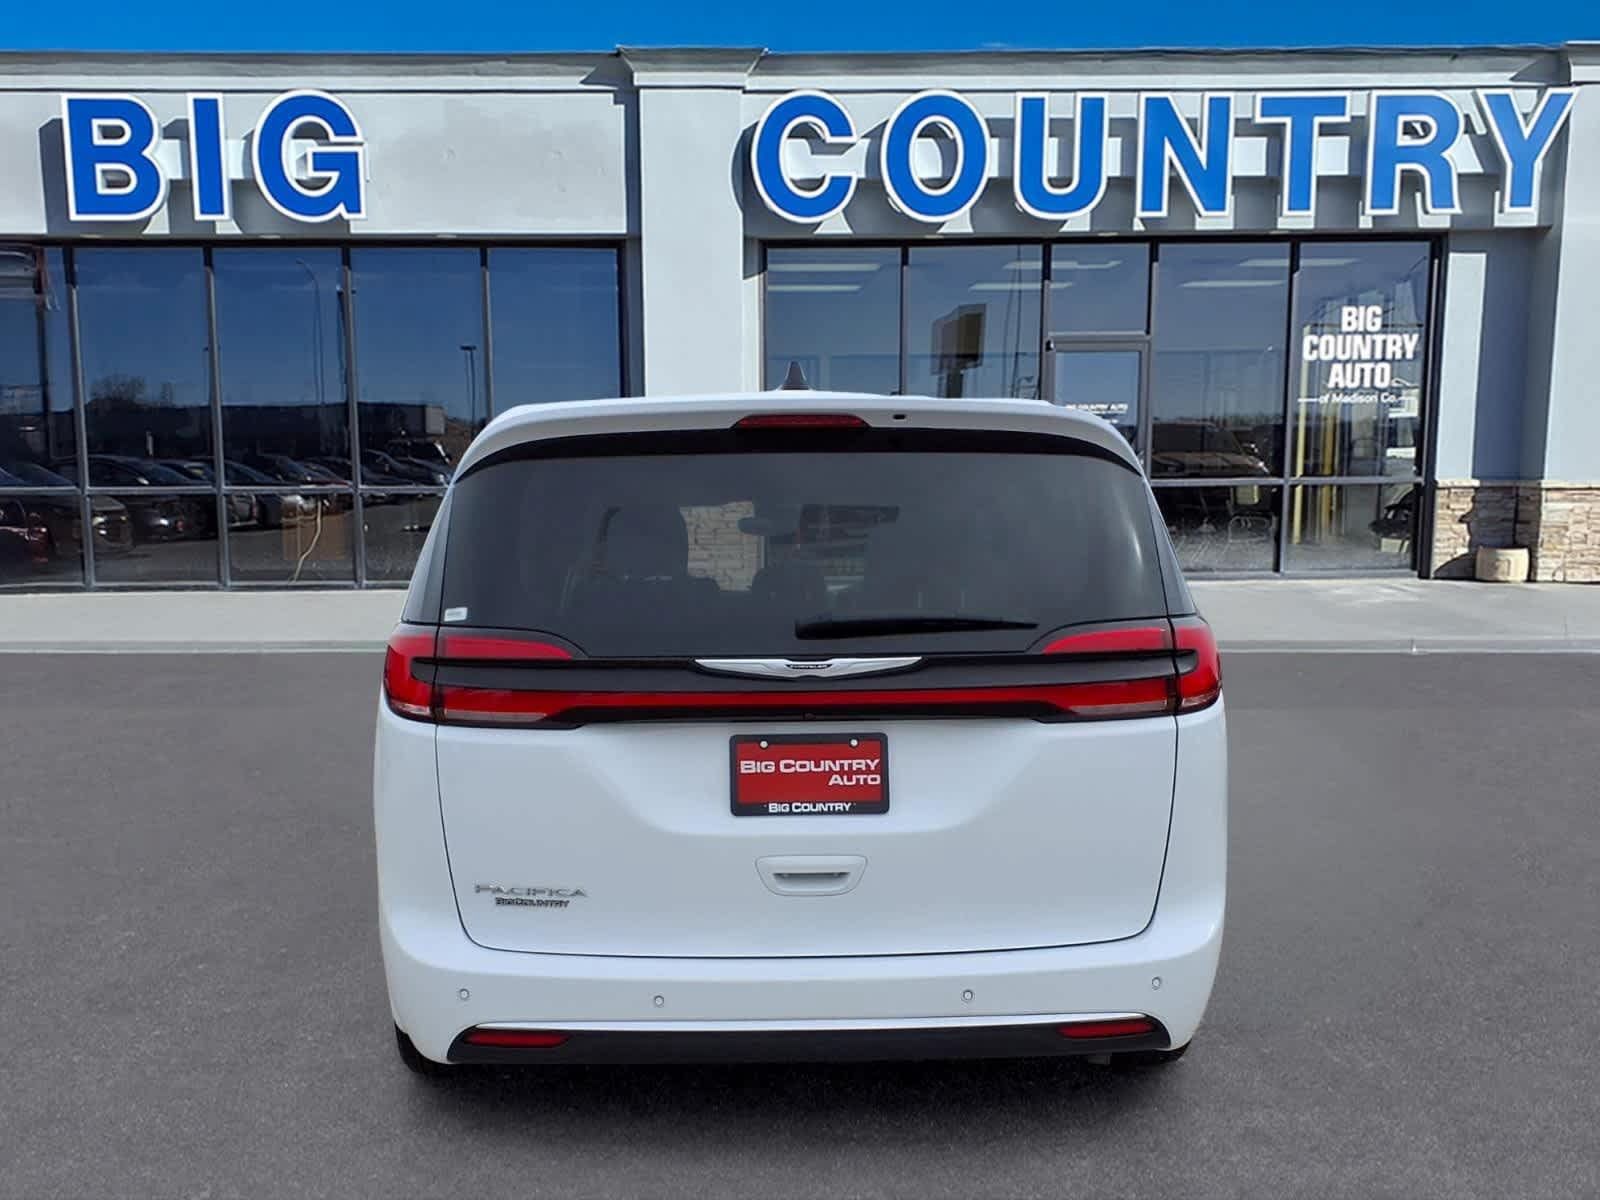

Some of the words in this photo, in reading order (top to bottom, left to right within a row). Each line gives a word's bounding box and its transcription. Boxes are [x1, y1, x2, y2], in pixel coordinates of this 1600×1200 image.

[61, 90, 367, 223] BIG
[750, 88, 1574, 225] COUNTRY
[1341, 306, 1382, 332] BIG
[1302, 334, 1419, 361] COUNTRY
[1327, 362, 1392, 389] AUTO
[740, 761, 775, 774] BIG
[779, 759, 880, 773] COUNTRY
[828, 775, 881, 786] AUTO
[768, 803, 789, 813] BIG
[791, 802, 852, 812] COUNTRY
[474, 883, 589, 898] PACIFICA
